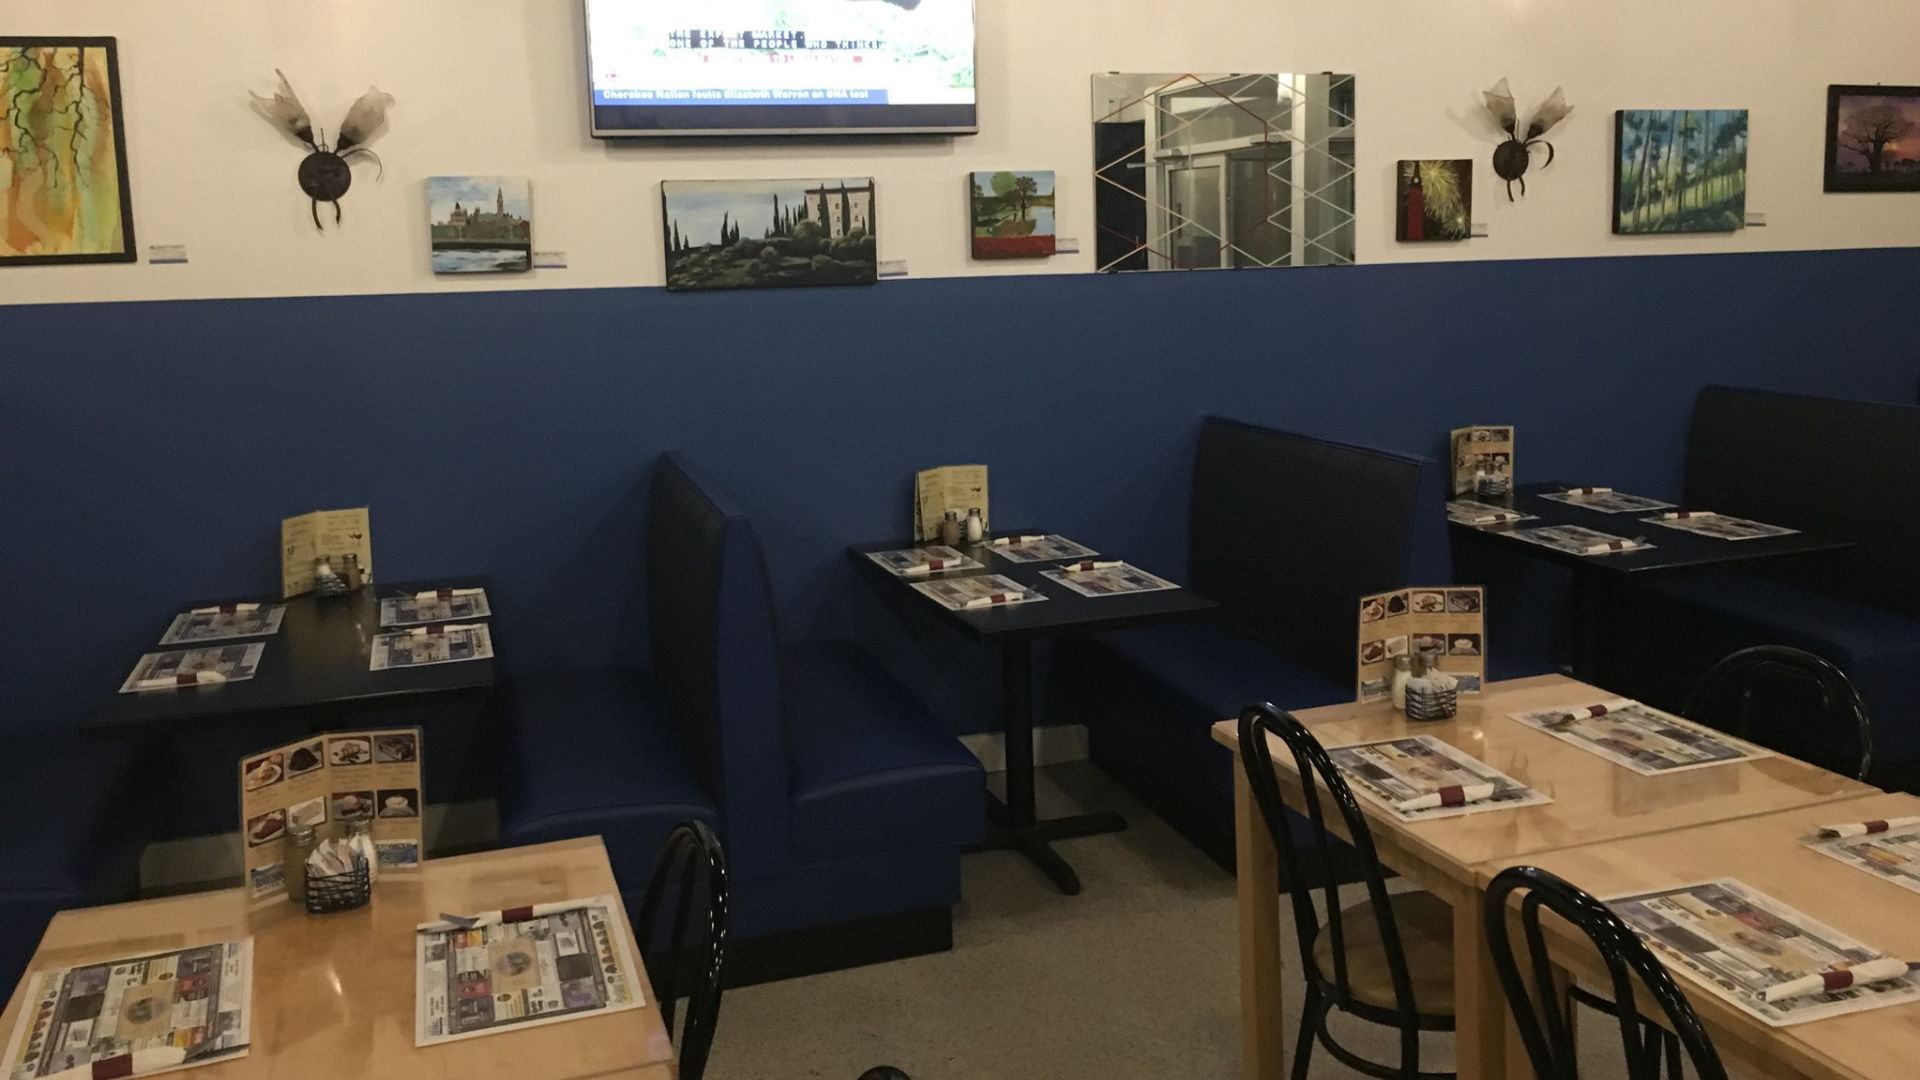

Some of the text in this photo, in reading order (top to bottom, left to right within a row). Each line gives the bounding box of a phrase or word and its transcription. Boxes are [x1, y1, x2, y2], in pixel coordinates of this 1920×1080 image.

[669, 39, 691, 49] ONE
[700, 39, 715, 49] OF
[723, 39, 744, 49] THE
[753, 39, 797, 49] PEOPLE
[804, 40, 828, 49] WHO
[602, 89, 653, 100] Cherokee
[656, 89, 690, 100] Nation
[724, 88, 770, 99] Elizabeth
[772, 88, 810, 99] Warren
[811, 89, 824, 99] on
[826, 88, 848, 99] DNA
[850, 88, 869, 99] test
